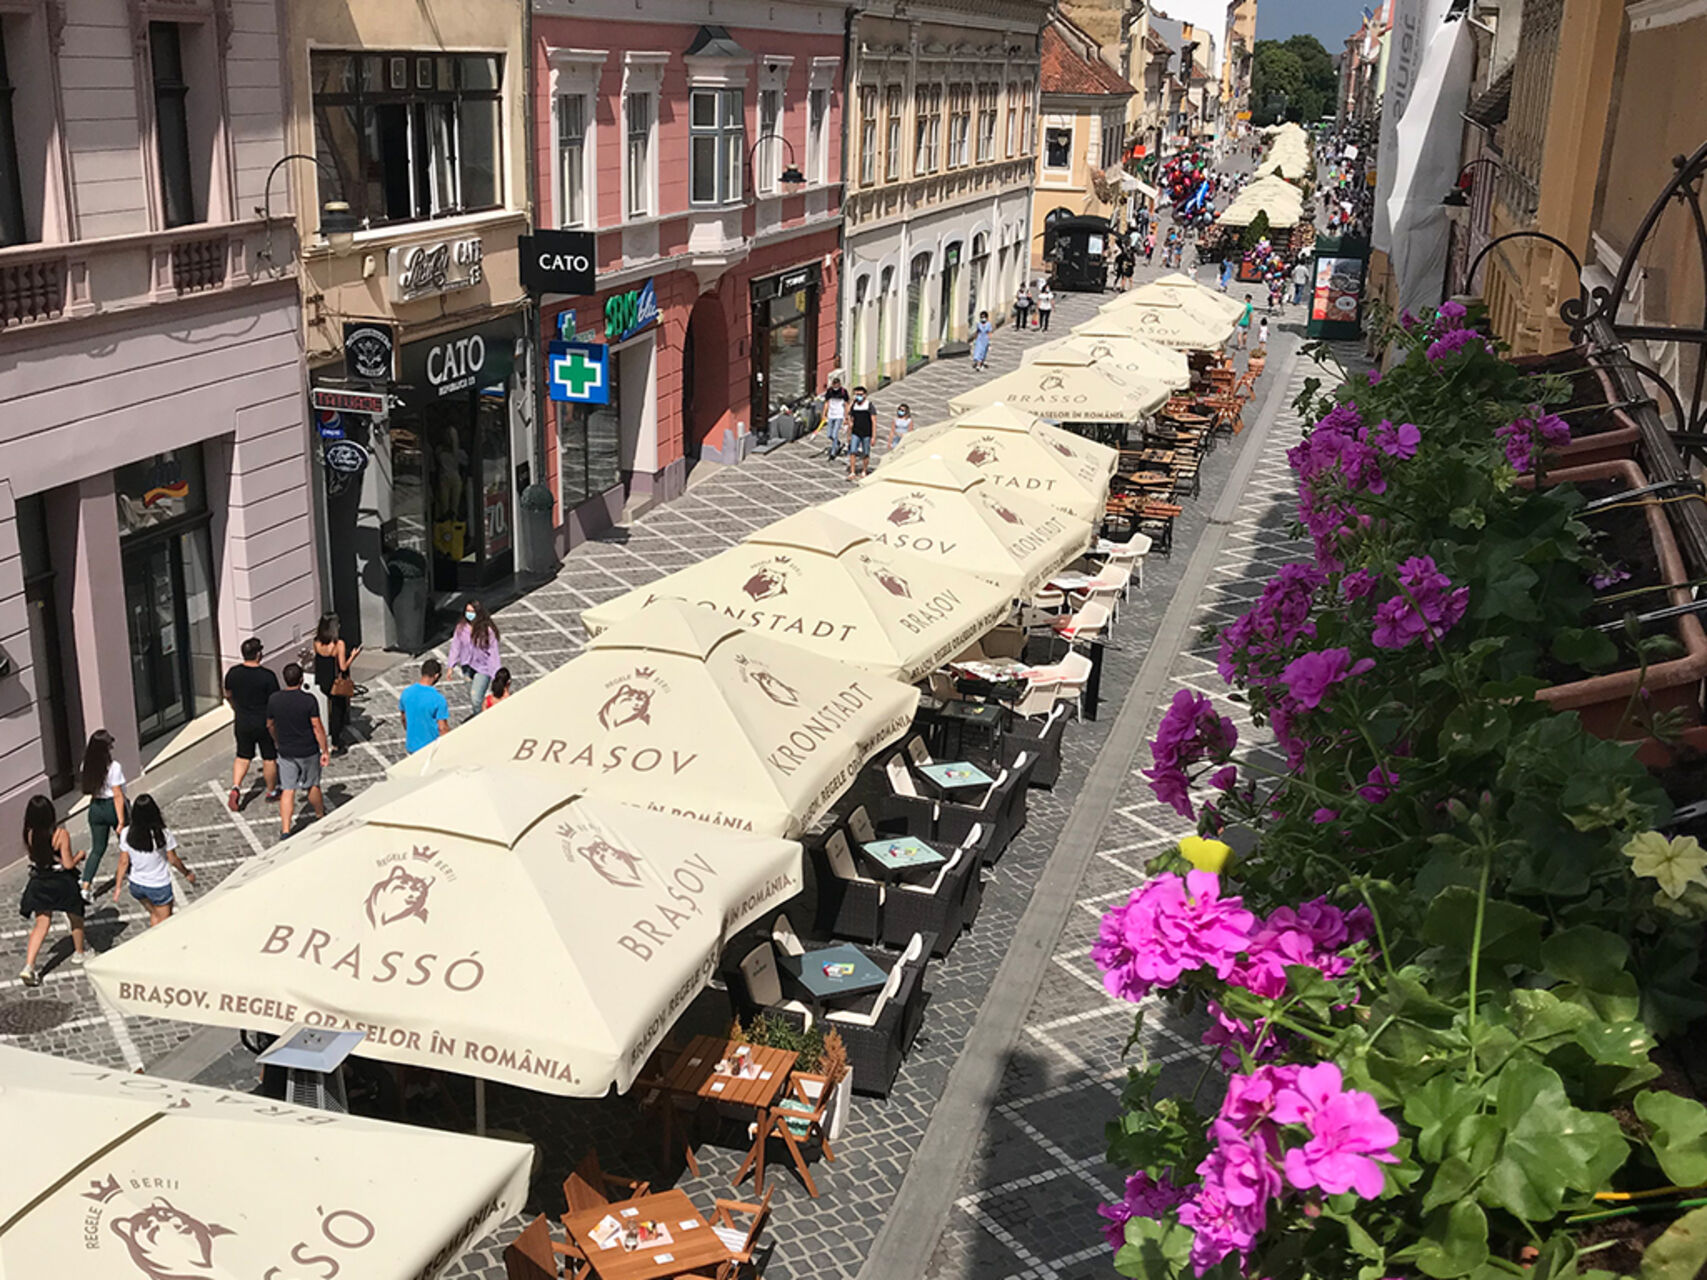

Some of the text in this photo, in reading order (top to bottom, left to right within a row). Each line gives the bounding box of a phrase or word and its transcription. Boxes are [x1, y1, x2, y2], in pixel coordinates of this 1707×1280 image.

[538, 253, 589, 272] CATO
[427, 335, 485, 385] CATO
[511, 738, 698, 775] BRAȘOV
[767, 682, 873, 777] KRONSTADT
[376, 852, 458, 883] REGELE BERII
[617, 852, 719, 962] BRAȘOV
[260, 924, 485, 992] BRASSÓ
[119, 982, 211, 1010] BRAȘOV.
[219, 993, 298, 1022] REGELE
[430, 1030, 456, 1056] ÎN
[464, 1041, 581, 1086] ROMÂNIA.
[84, 1177, 178, 1249] REGELE BERII
